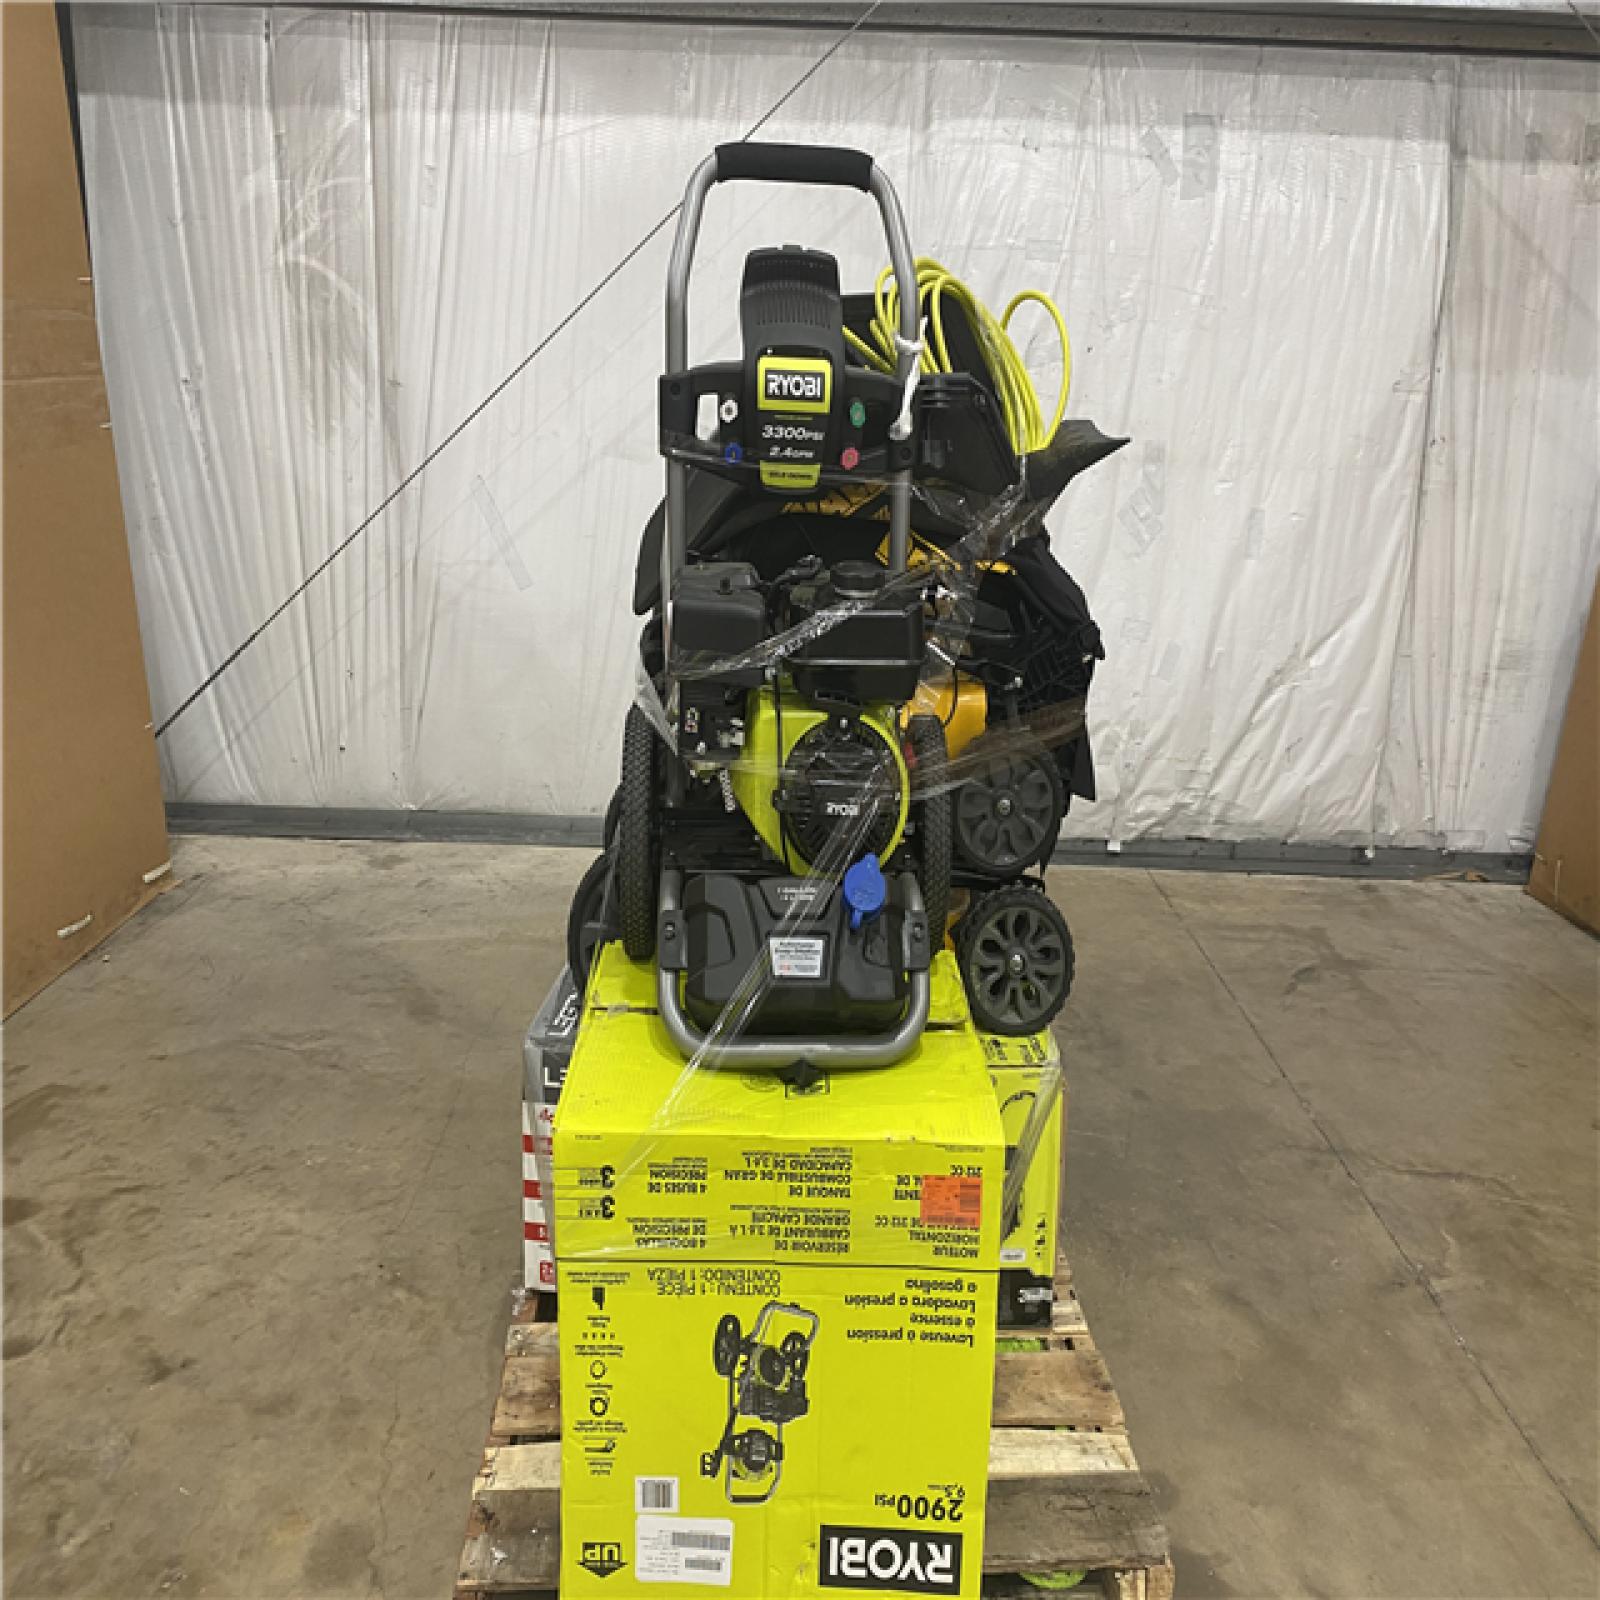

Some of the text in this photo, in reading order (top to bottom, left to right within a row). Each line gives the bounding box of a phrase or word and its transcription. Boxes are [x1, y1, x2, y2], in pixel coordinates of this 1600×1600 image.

[767, 374, 820, 398] RYOBI
[600, 1165, 615, 1189] 3
[724, 1170, 851, 1184] COMBUSTIBLE DE GRAN
[789, 1185, 850, 1198] TANQUE DE
[600, 1195, 615, 1220] 3
[804, 1215, 850, 1225] GRANDE
[768, 1225, 780, 1235] DE
[784, 1227, 850, 1239] CARBURANT
[908, 1230, 980, 1245] HORIZONTAL
[775, 1240, 788, 1250] DE
[932, 1246, 979, 1258] MOTEUR
[905, 1279, 963, 1294] gasolina
[844, 1293, 895, 1309] presión
[912, 1296, 975, 1313] Lavadora
[910, 1313, 962, 1326] essence
[847, 1327, 903, 1343] pression
[920, 1331, 974, 1348] Laveuse
[585, 1545, 618, 1561] UP
[829, 1536, 953, 1583] RYOBI
